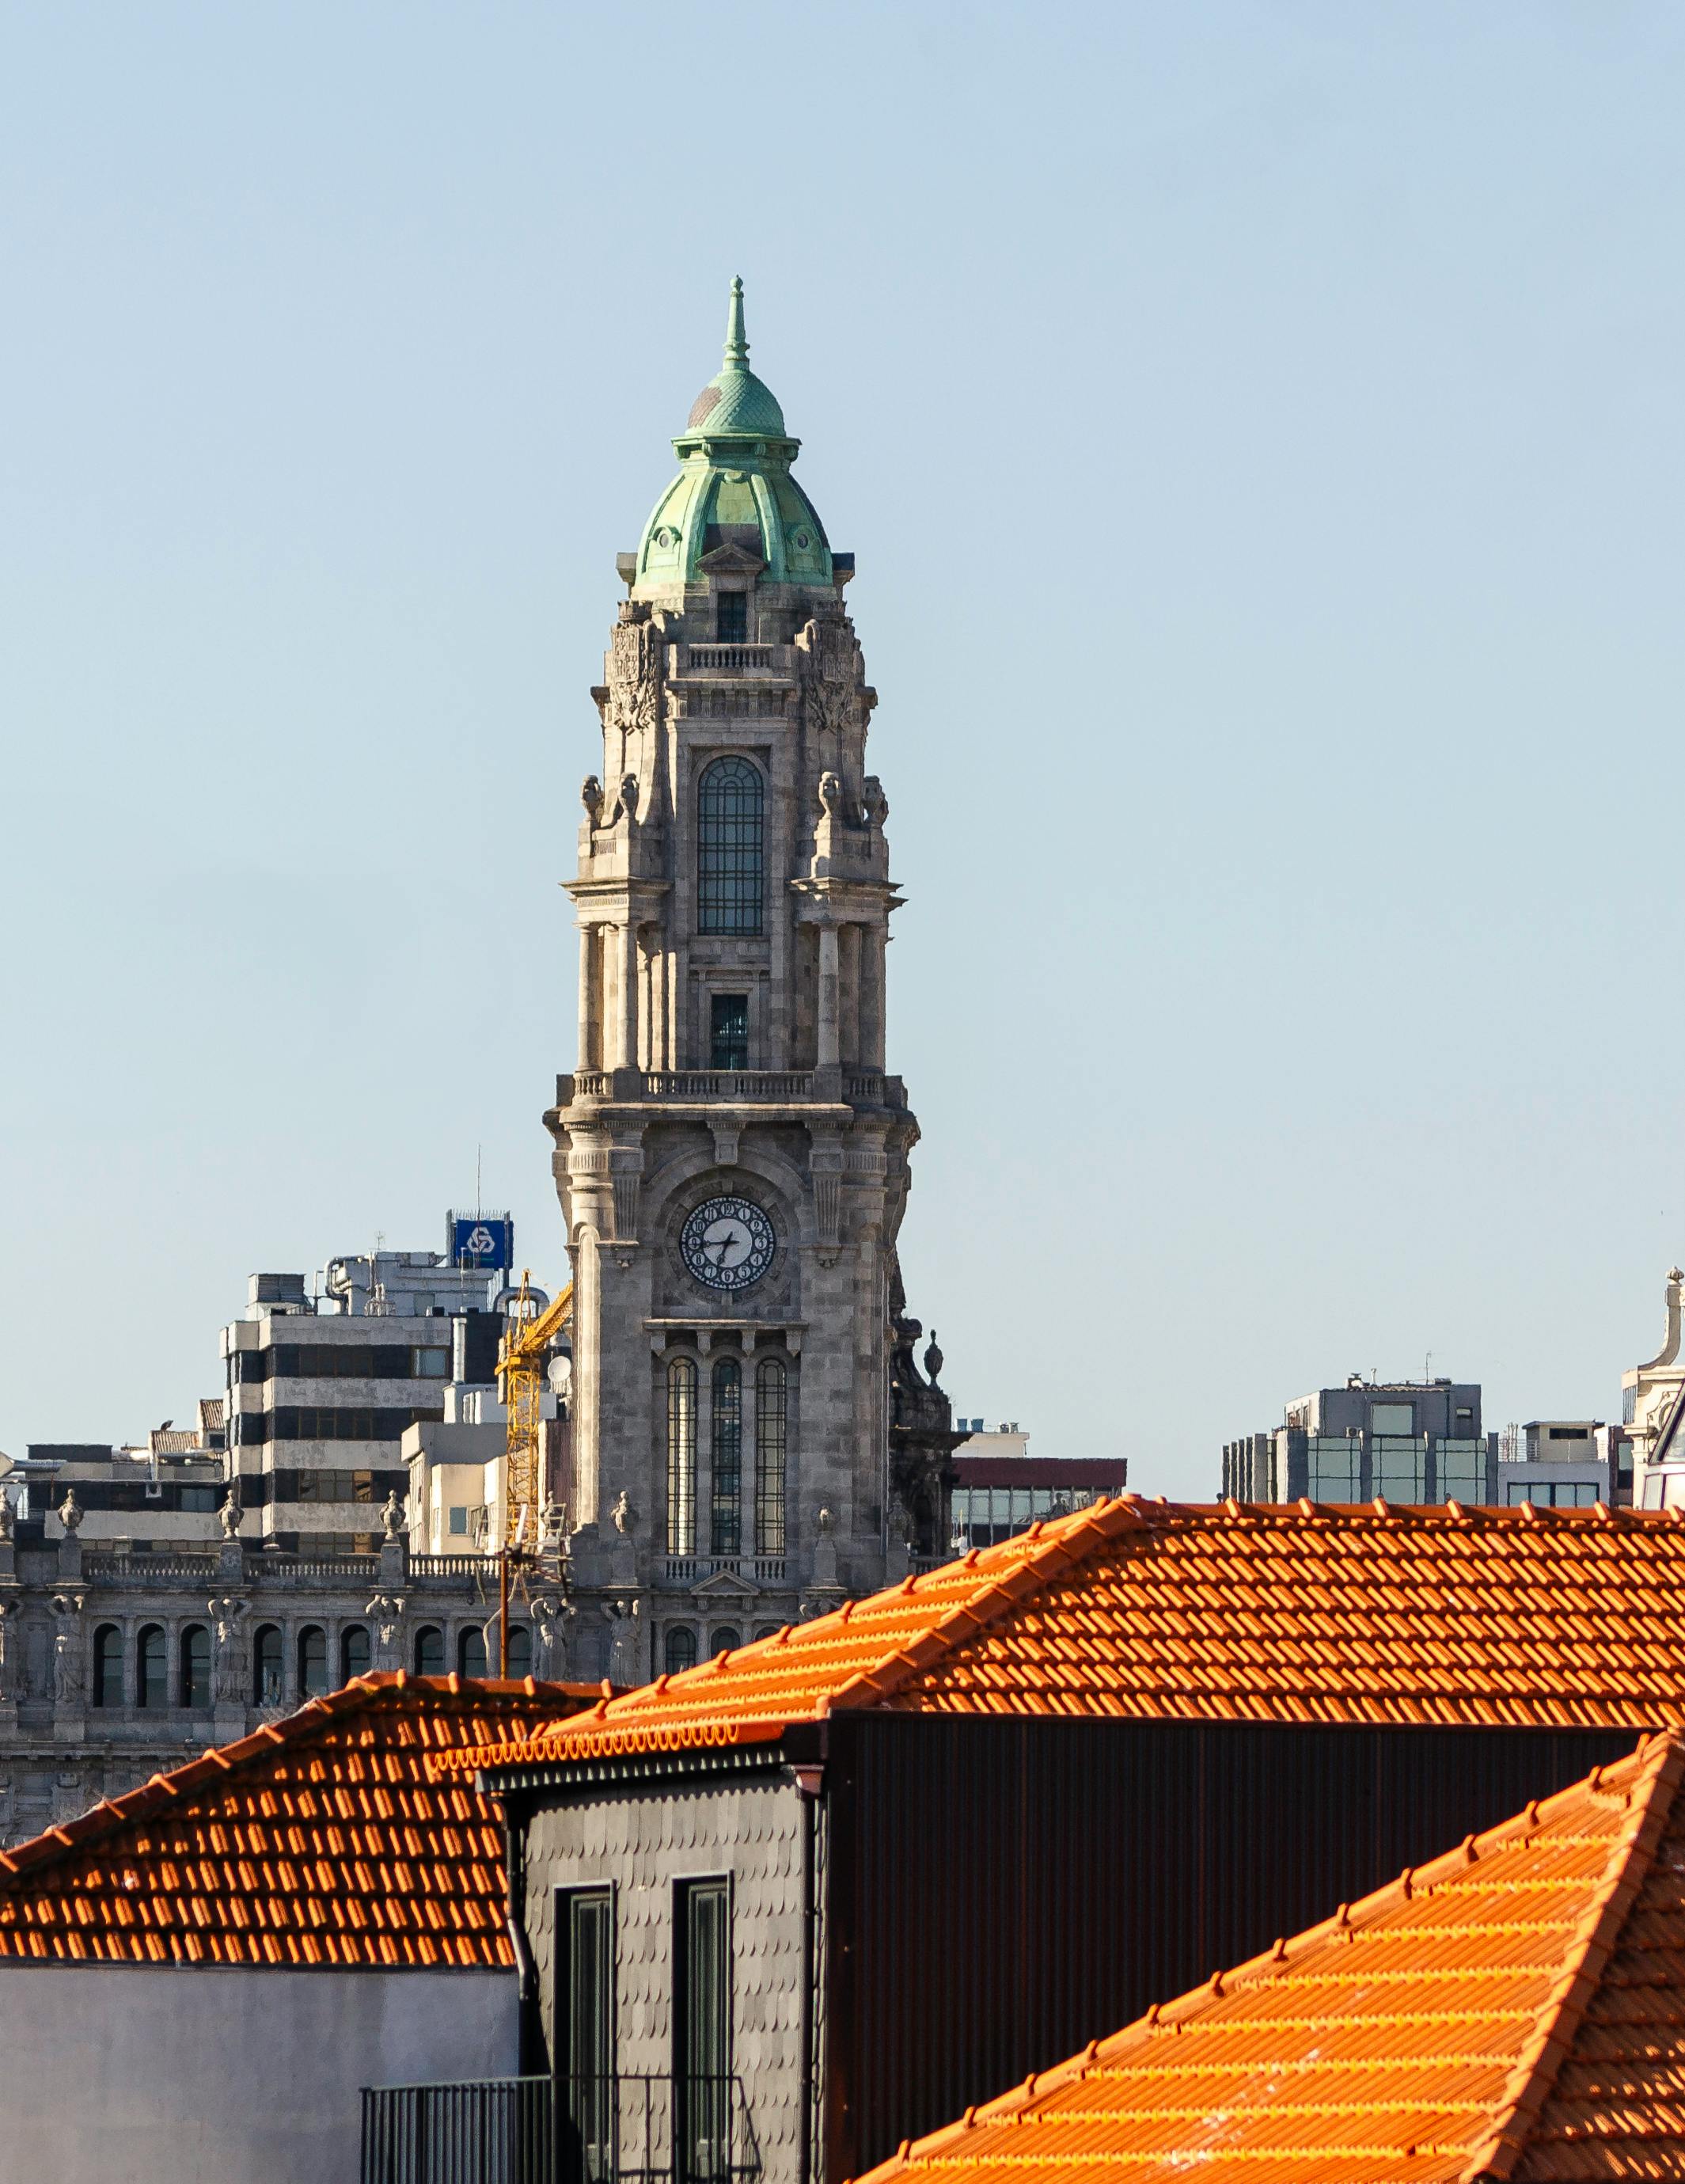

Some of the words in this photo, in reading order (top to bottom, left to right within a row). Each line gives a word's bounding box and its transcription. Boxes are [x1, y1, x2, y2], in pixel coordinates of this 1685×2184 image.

[708, 1208, 714, 1219] 11
[723, 1204, 732, 1215] 12
[695, 1221, 704, 1232] 10
[753, 1221, 760, 1232] 2
[692, 1237, 696, 1248] 9
[758, 1237, 764, 1248] 3
[696, 1254, 701, 1265] 8
[753, 1254, 759, 1265] 4
[708, 1267, 713, 1277] 7
[724, 1271, 731, 1282] 6
[742, 1267, 747, 1278] 5
